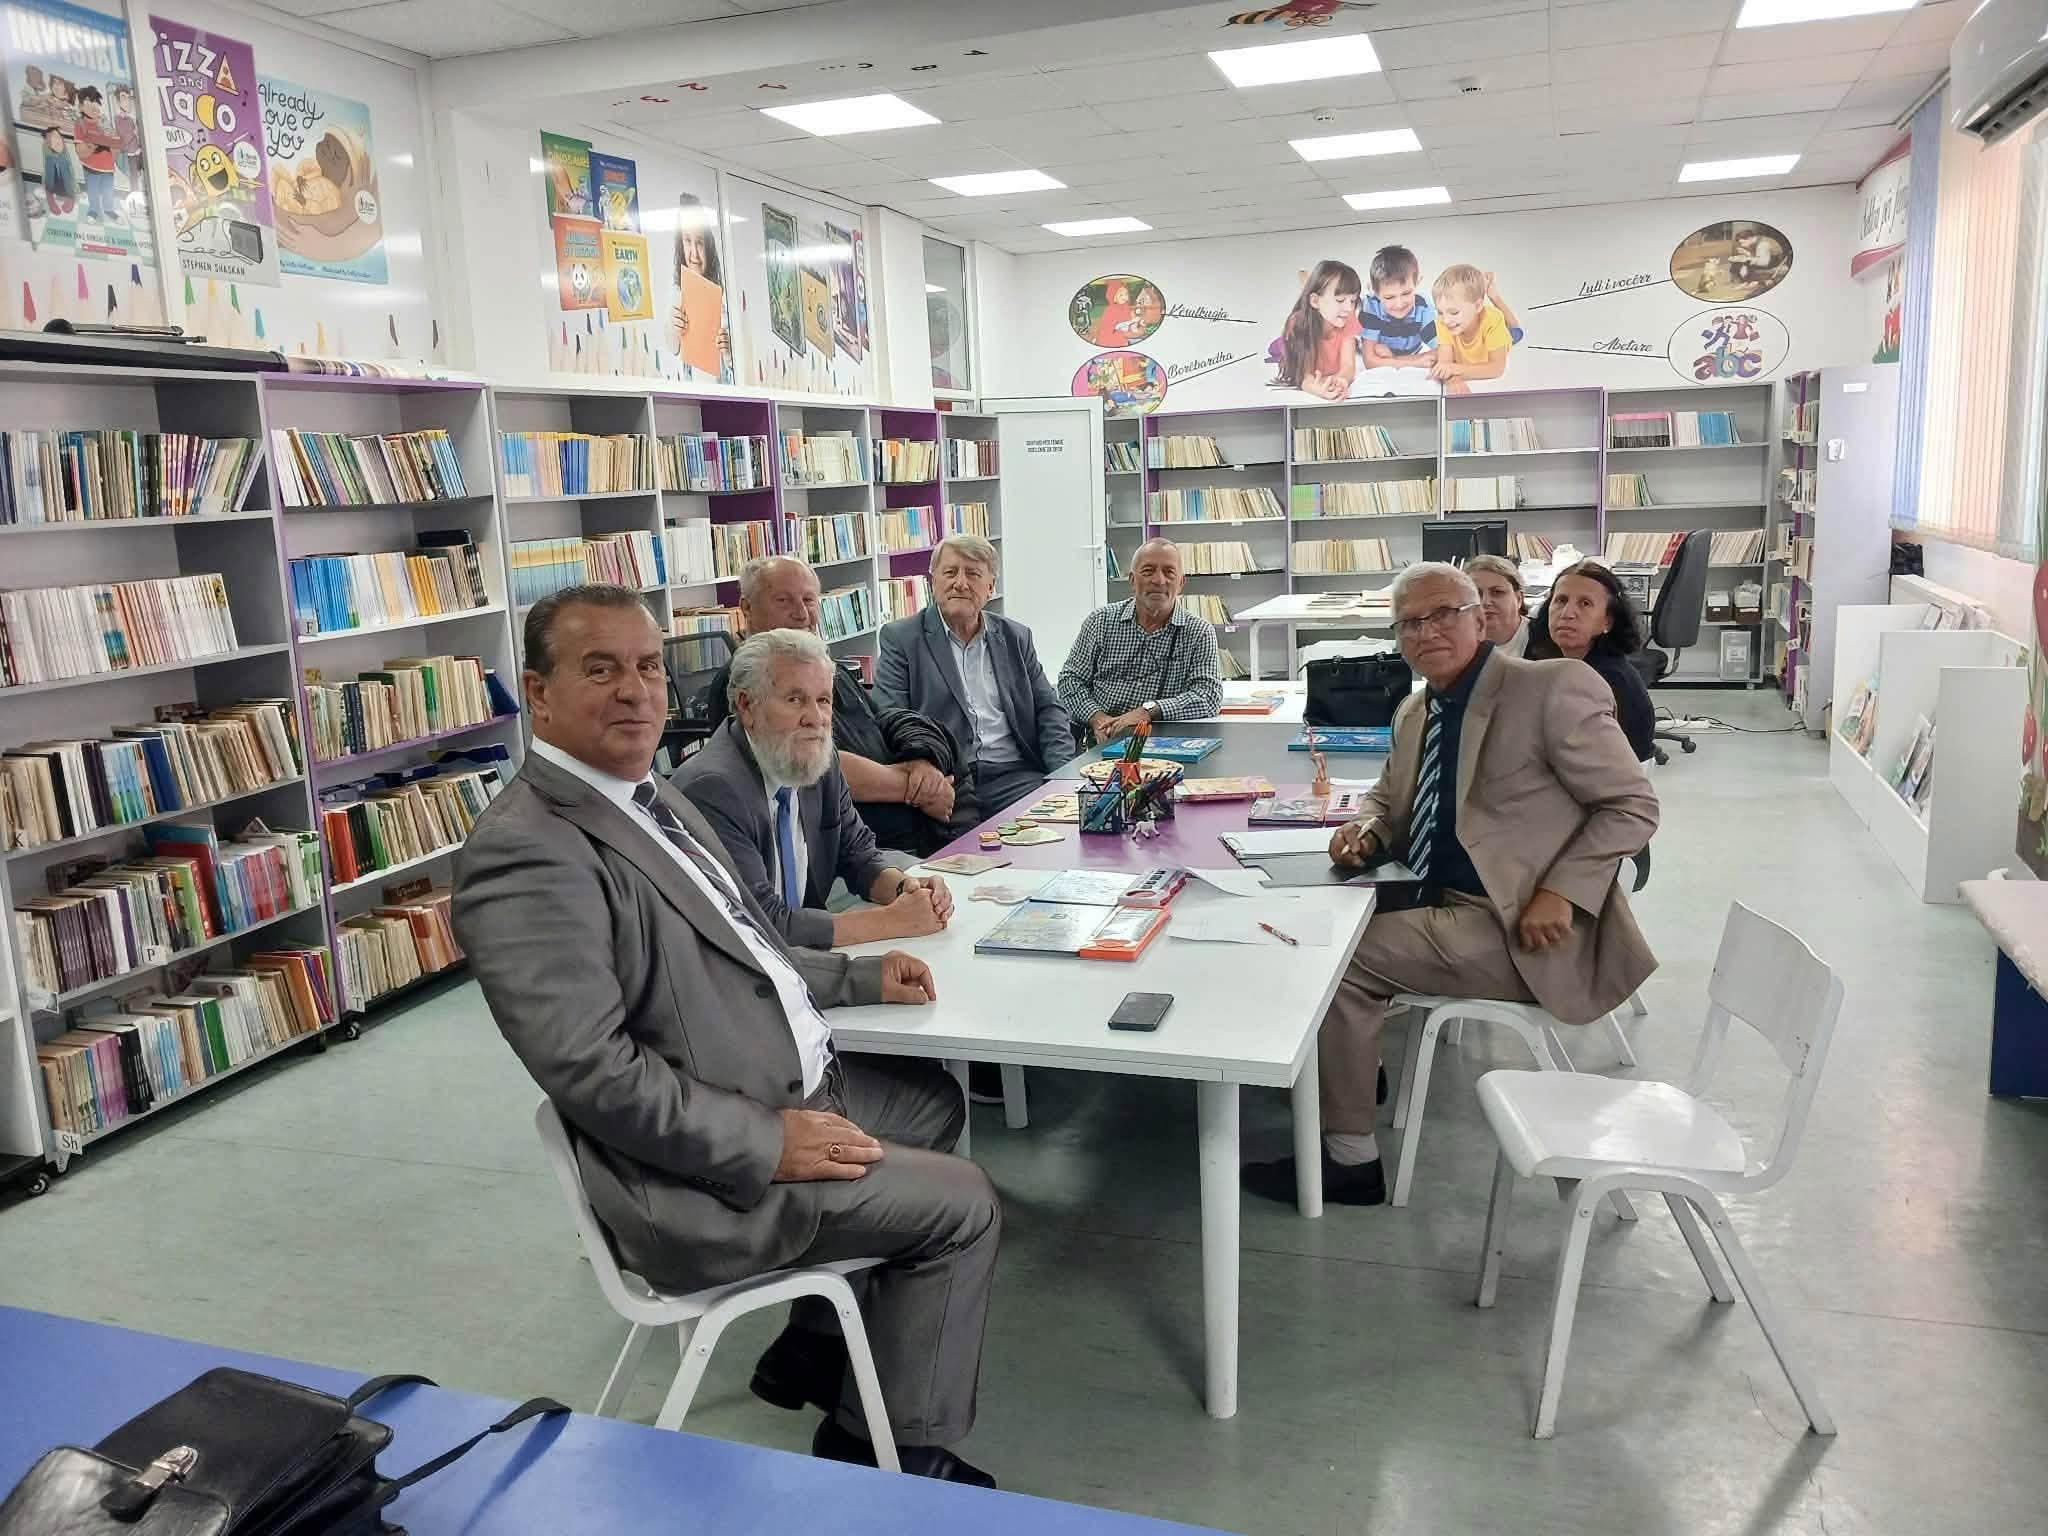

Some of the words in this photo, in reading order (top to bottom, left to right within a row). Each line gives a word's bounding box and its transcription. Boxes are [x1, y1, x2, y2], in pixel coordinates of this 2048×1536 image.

[266, 126, 305, 159] You
[614, 247, 640, 261] EARTH
[182, 259, 212, 273] STEPHEN
[214, 262, 245, 276] SHASKAN
[146, 948, 155, 961] P
[62, 1134, 78, 1150] Sh
